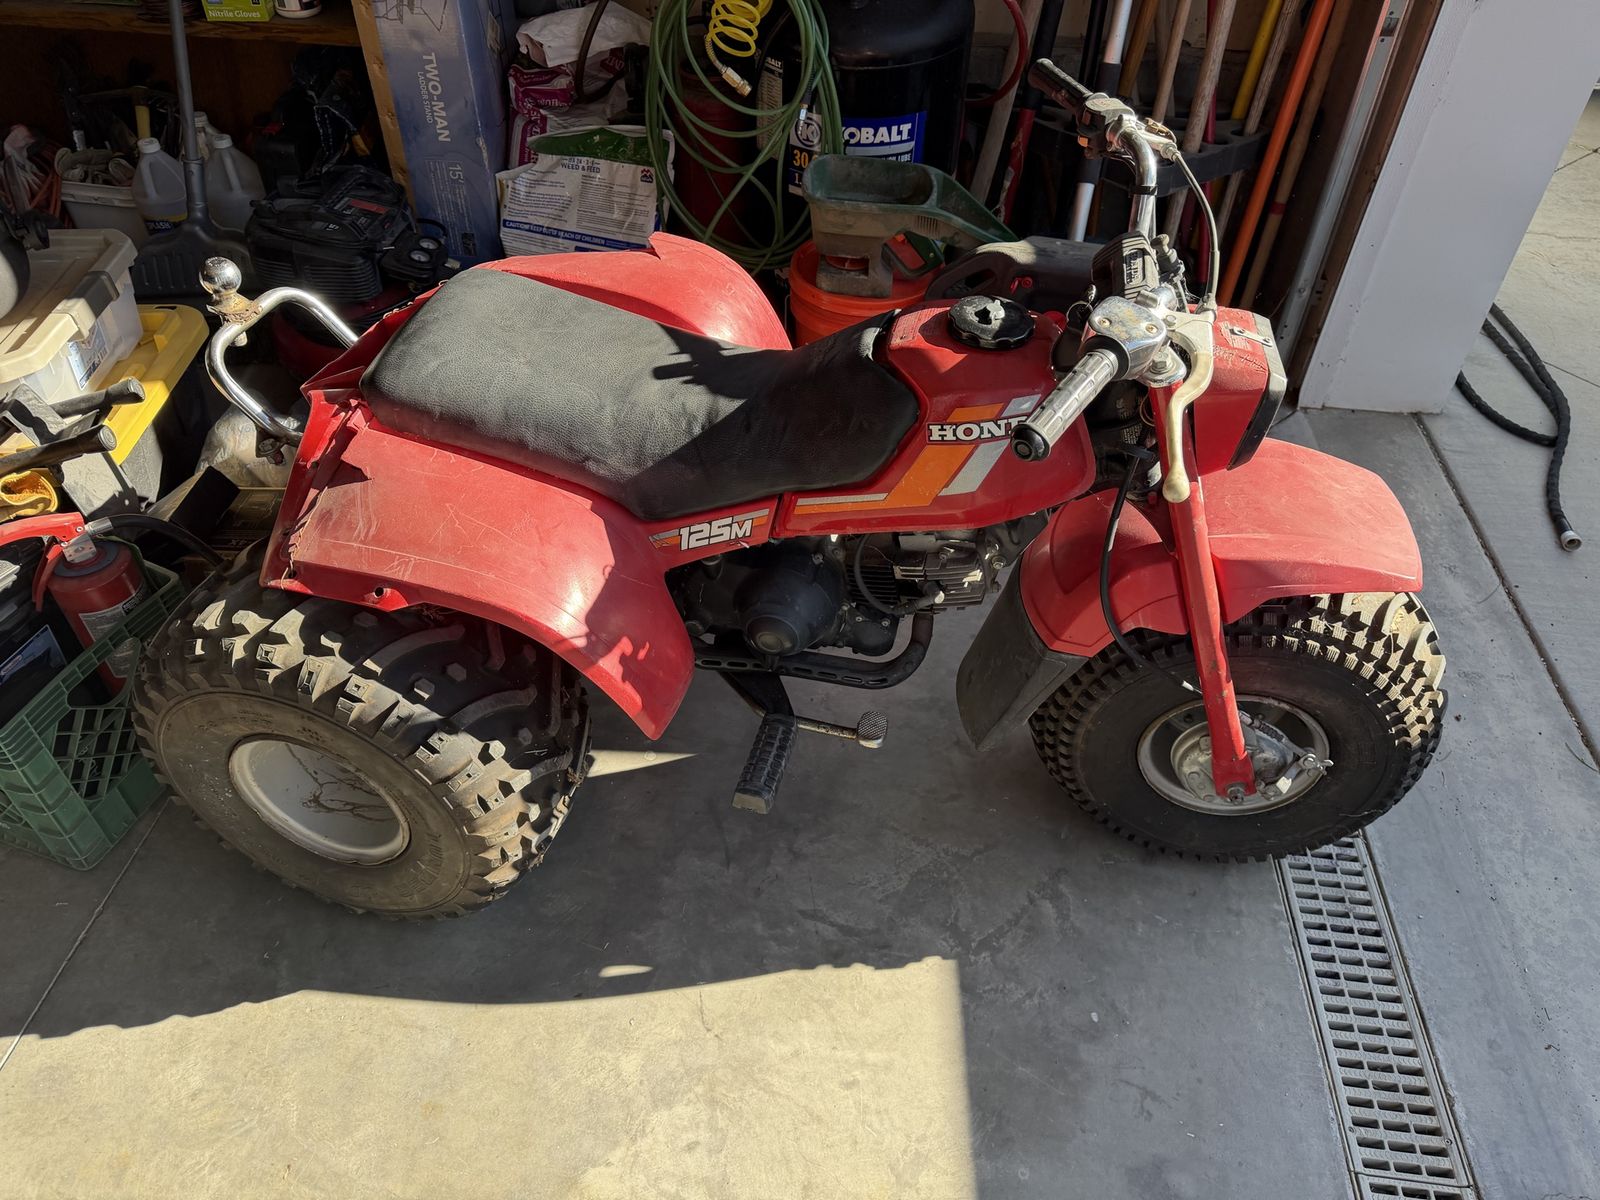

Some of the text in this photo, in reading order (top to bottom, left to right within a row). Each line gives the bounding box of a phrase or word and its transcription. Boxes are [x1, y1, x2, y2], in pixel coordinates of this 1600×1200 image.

[208, 9, 261, 18] Nitrile Gloves
[417, 71, 433, 124] LADDER STAND
[422, 52, 451, 143] TWO-MAN
[842, 123, 912, 145] OBALT
[561, 162, 579, 170] WEED
[586, 165, 601, 174] FEED
[792, 149, 809, 168] 30
[928, 415, 1027, 442] HON
[679, 516, 754, 551] 125M
